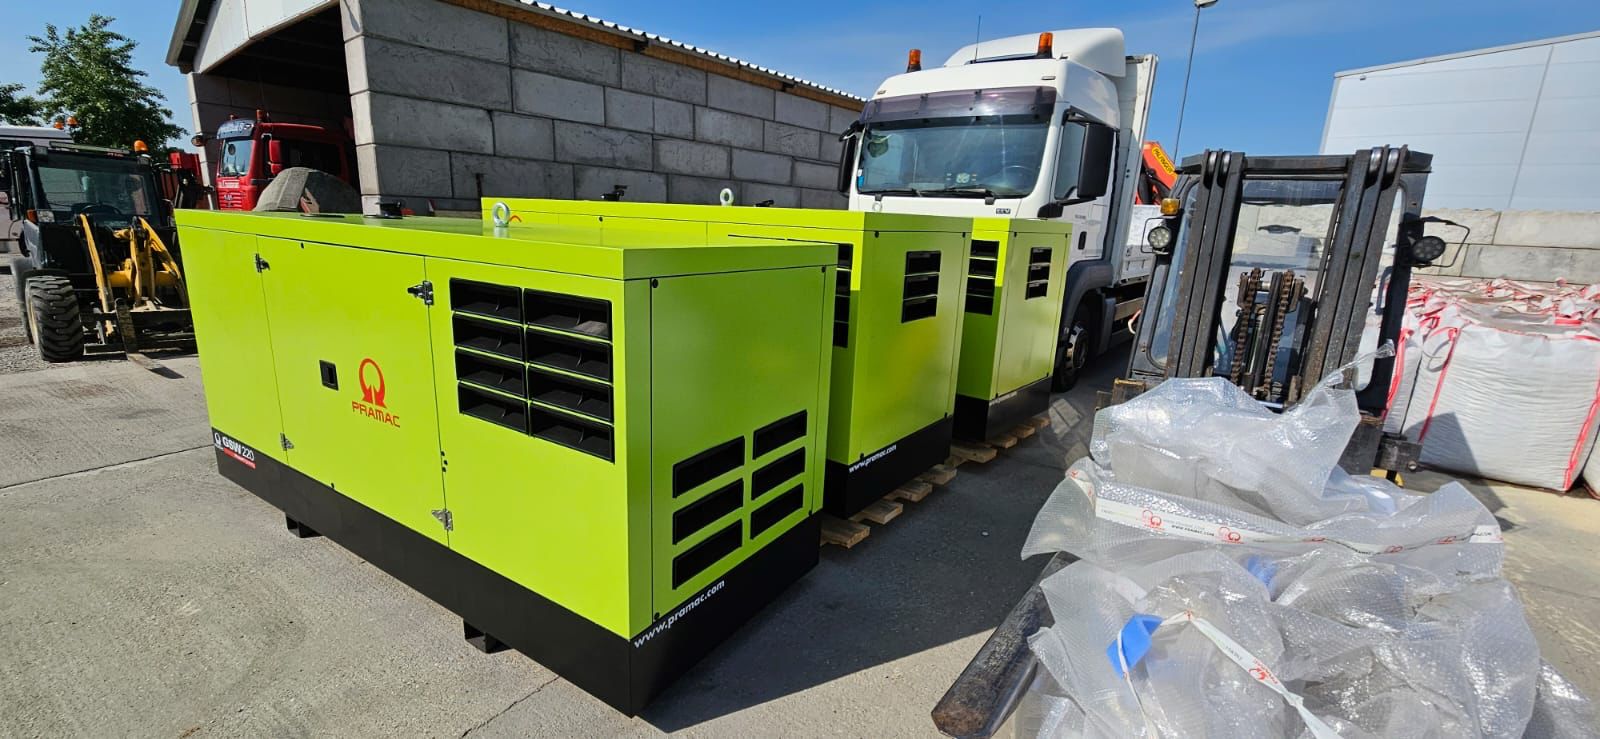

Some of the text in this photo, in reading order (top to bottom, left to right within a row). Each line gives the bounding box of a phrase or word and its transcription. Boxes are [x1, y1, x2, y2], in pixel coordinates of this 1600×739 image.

[351, 400, 401, 428] PRAMAC
[222, 436, 242, 455] GSW
[241, 446, 255, 462] 220
[849, 444, 897, 473] www.pramac.com
[633, 579, 725, 649] www.pramac.com
